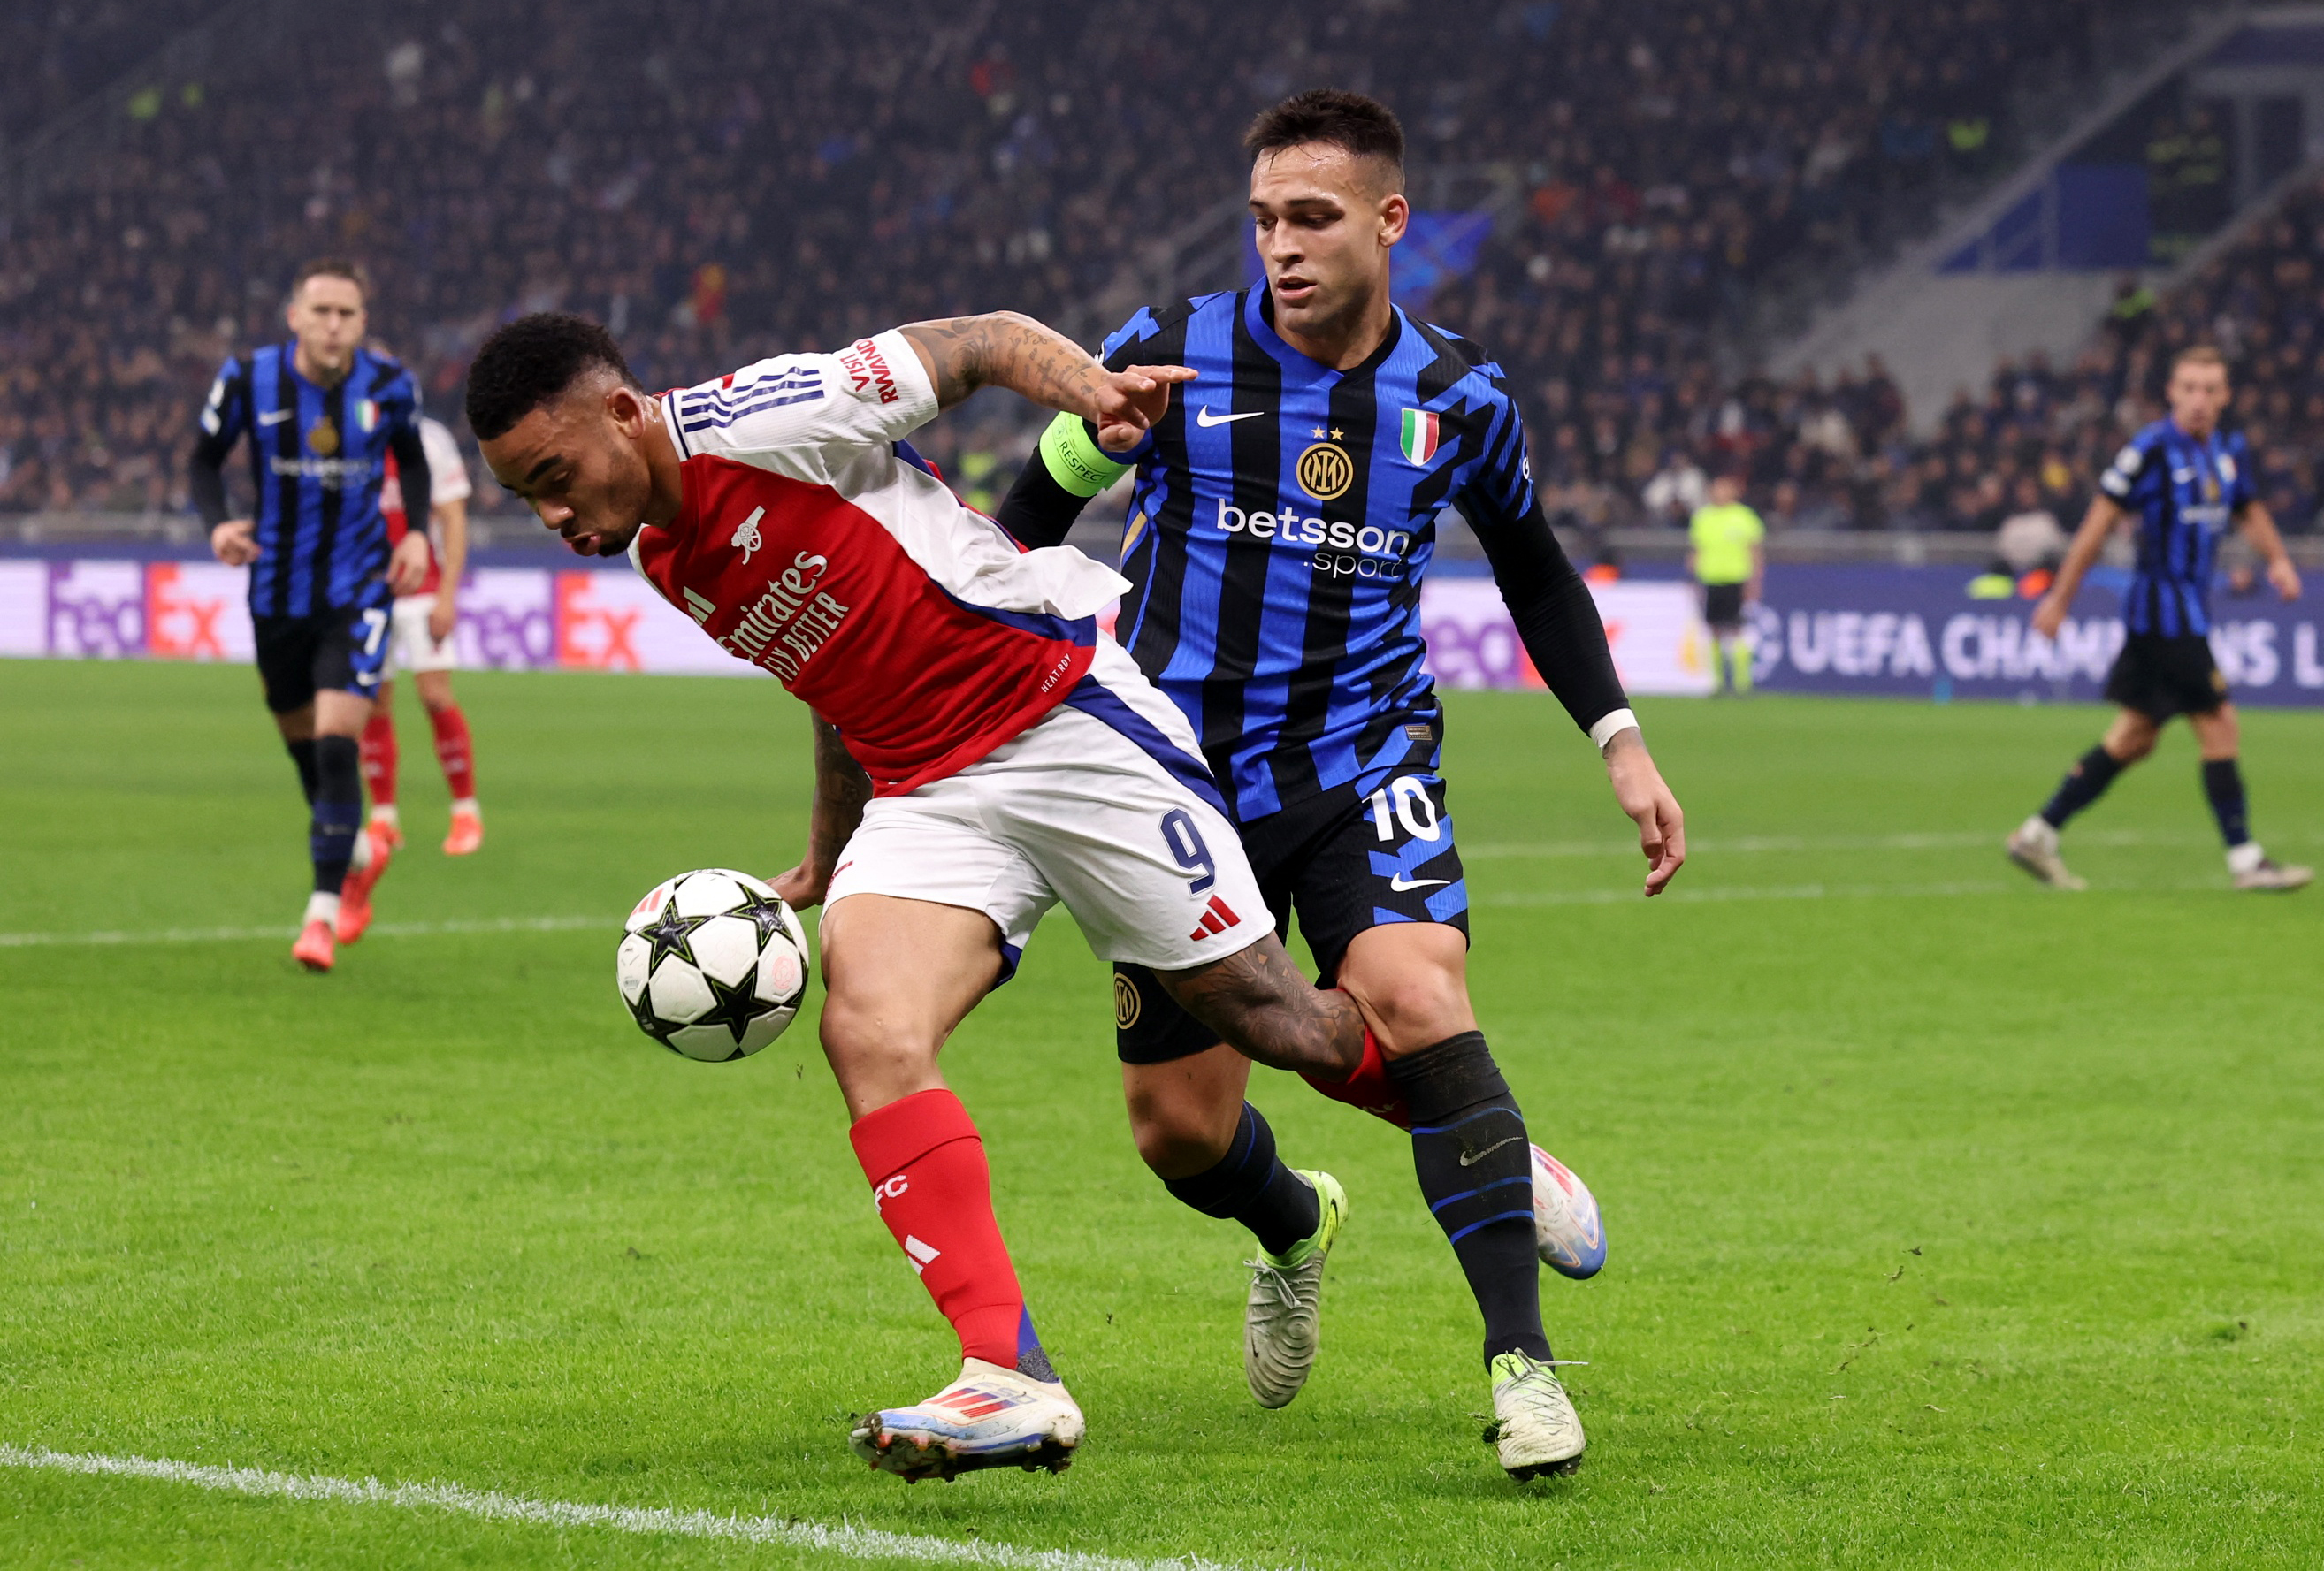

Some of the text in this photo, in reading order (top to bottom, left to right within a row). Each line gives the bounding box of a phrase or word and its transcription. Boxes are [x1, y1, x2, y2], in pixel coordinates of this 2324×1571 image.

[839, 353, 870, 393] VISIT
[1217, 498, 1410, 555] betsson
[47, 560, 225, 658] FedEx
[363, 607, 387, 655] 7
[763, 591, 850, 682] FLY BETTER
[1041, 652, 1072, 693] HEAT.RDY
[1788, 611, 1936, 676] UEFA
[1362, 775, 1441, 843] 10
[1158, 805, 1217, 898] 9
